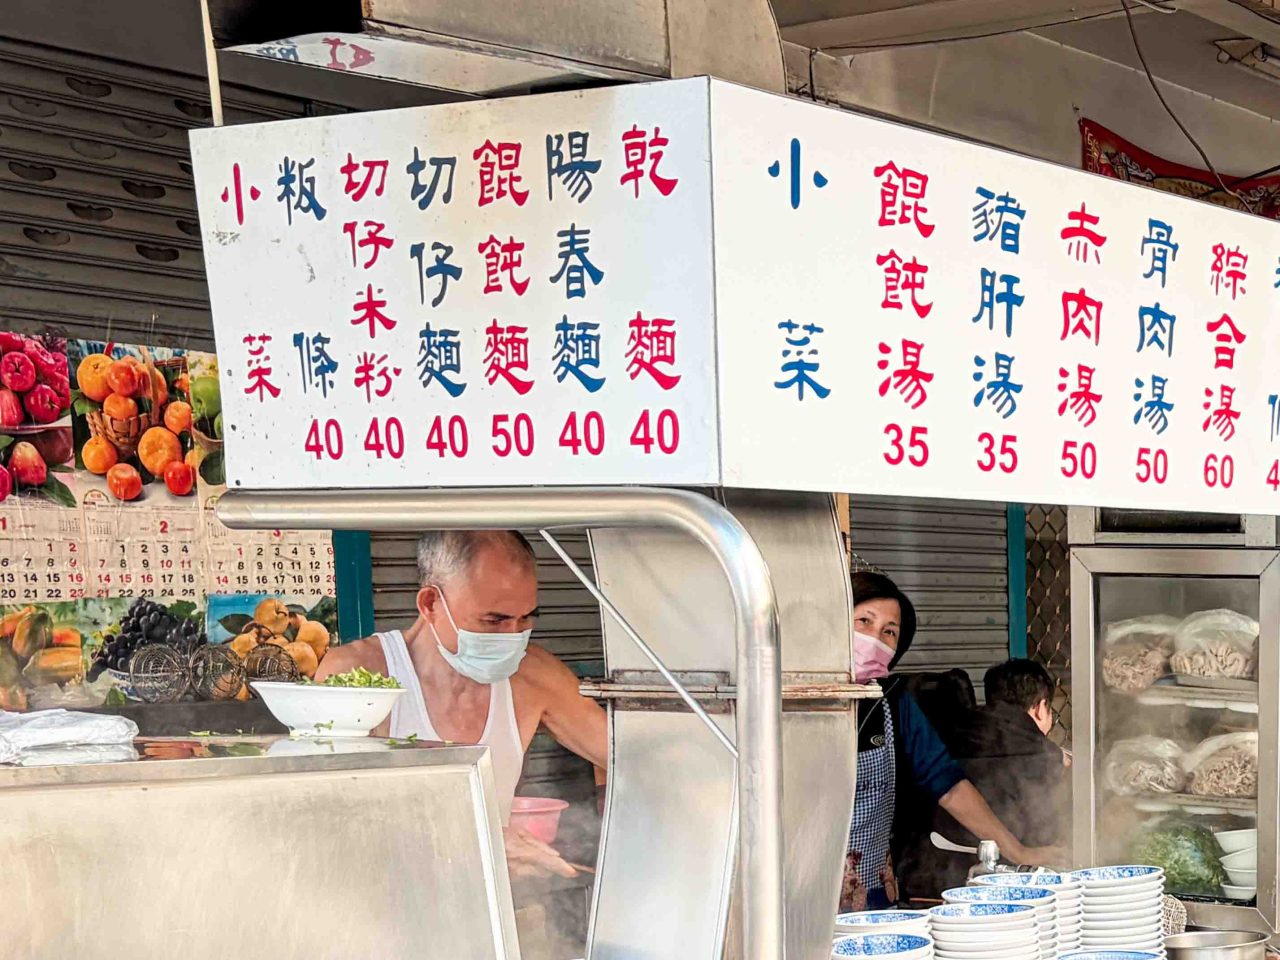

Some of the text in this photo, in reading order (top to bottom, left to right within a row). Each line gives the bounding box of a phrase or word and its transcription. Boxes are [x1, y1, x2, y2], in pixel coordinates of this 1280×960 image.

[221, 164, 280, 402] 小菜
[278, 157, 343, 460] 粄條 40
[340, 153, 404, 459] 切仔米粉 40
[407, 147, 468, 458] 切仔麵 40
[473, 139, 534, 457] 餛飩麵 50
[546, 132, 605, 455] 陽春麵 40
[620, 125, 680, 454] 乾麵 40
[769, 139, 830, 400] 小菜
[874, 161, 935, 467] 餛飩湯 35
[973, 187, 1025, 473] 豬肝湯 35
[1058, 203, 1107, 479] 赤肉湯 50
[1134, 218, 1179, 484] 骨肉湯 50
[1202, 243, 1248, 488] 綜合湯 60
[0, 573, 83, 582] 13 14 15 16
[1, 589, 16, 598] 20
[24, 589, 38, 598] 21
[46, 589, 62, 598] 22
[97, 574, 195, 583] 14 15 16 17 18
[118, 589, 134, 597] 22
[140, 589, 154, 597] 23
[161, 589, 174, 597] 24
[182, 589, 195, 597] 25
[160, 559, 173, 568] 10
[180, 559, 192, 568] 11
[216, 576, 229, 585] 14
[236, 576, 249, 585] 15
[256, 576, 268, 584] 16
[274, 575, 285, 584] 17
[293, 575, 304, 584] 18
[309, 575, 320, 583] 19
[272, 562, 284, 570] 10
[290, 562, 301, 570] 11
[309, 561, 321, 570] 12
